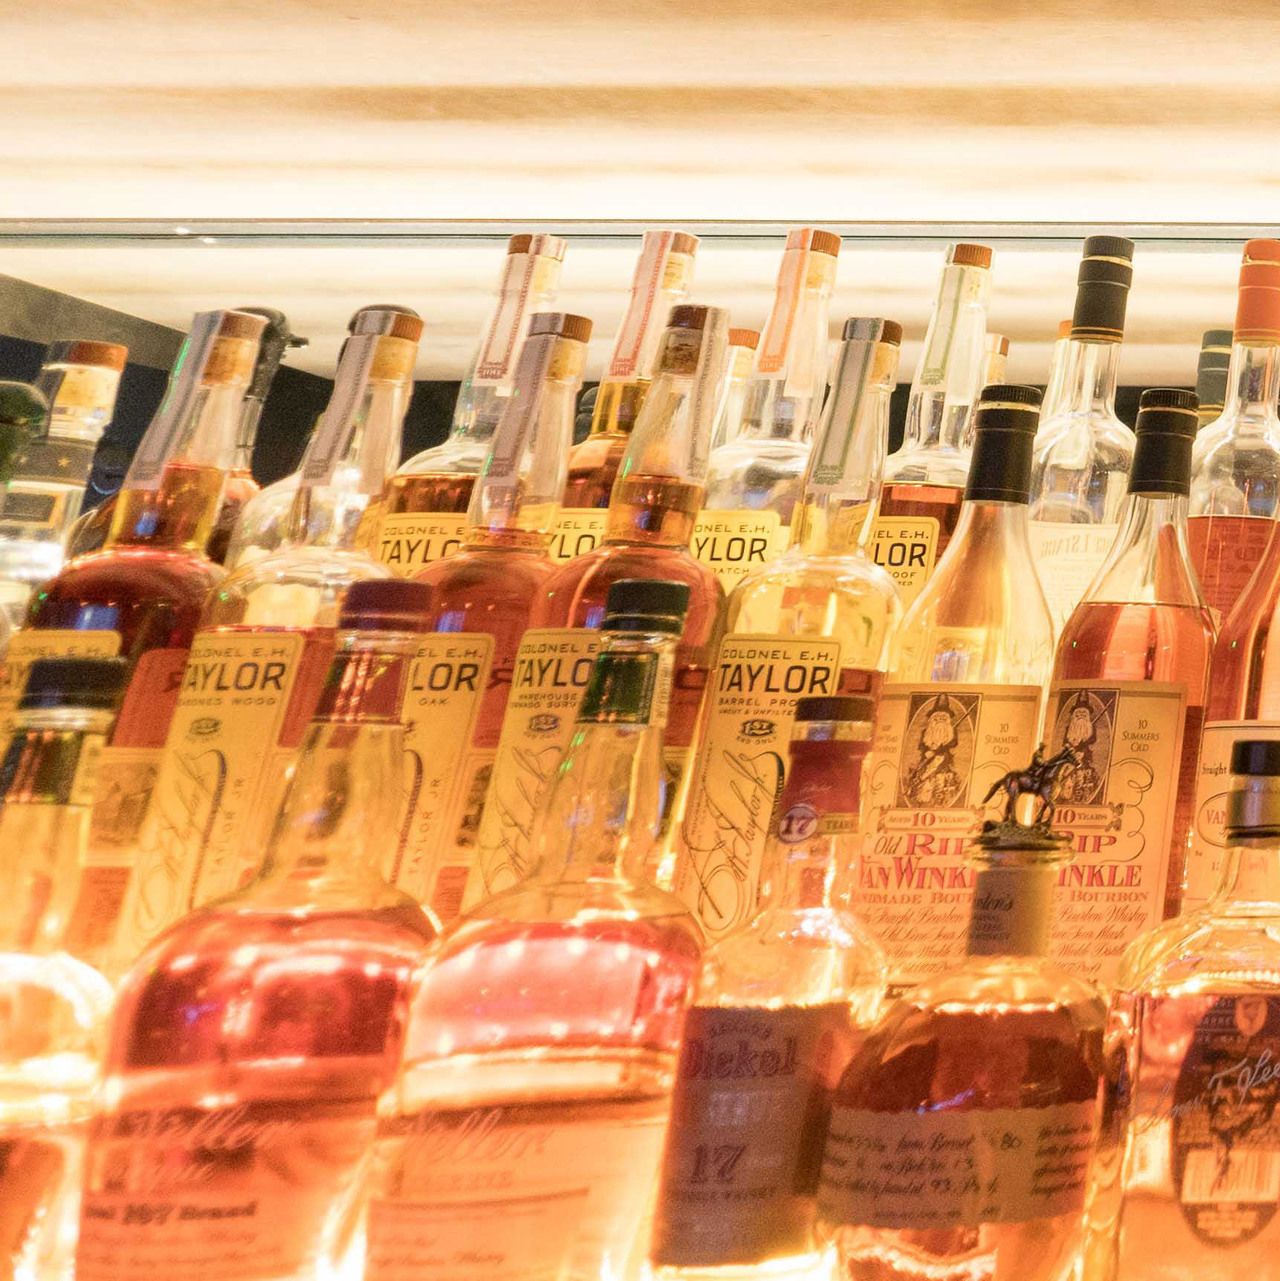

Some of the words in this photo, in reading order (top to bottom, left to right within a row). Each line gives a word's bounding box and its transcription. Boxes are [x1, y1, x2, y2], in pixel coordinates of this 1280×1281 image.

[721, 649, 791, 660] COLONEL
[799, 650, 834, 661] E.H.
[718, 664, 831, 694] TAYLOR
[718, 698, 760, 706] BARREL
[1122, 731, 1160, 742] SUMMERS
[911, 812, 936, 827] 10
[1056, 808, 1077, 824] 10
[783, 814, 816, 835] 17
[874, 835, 900, 856] Old
[905, 833, 976, 856] RIP
[1070, 891, 1148, 903] BOURBON
